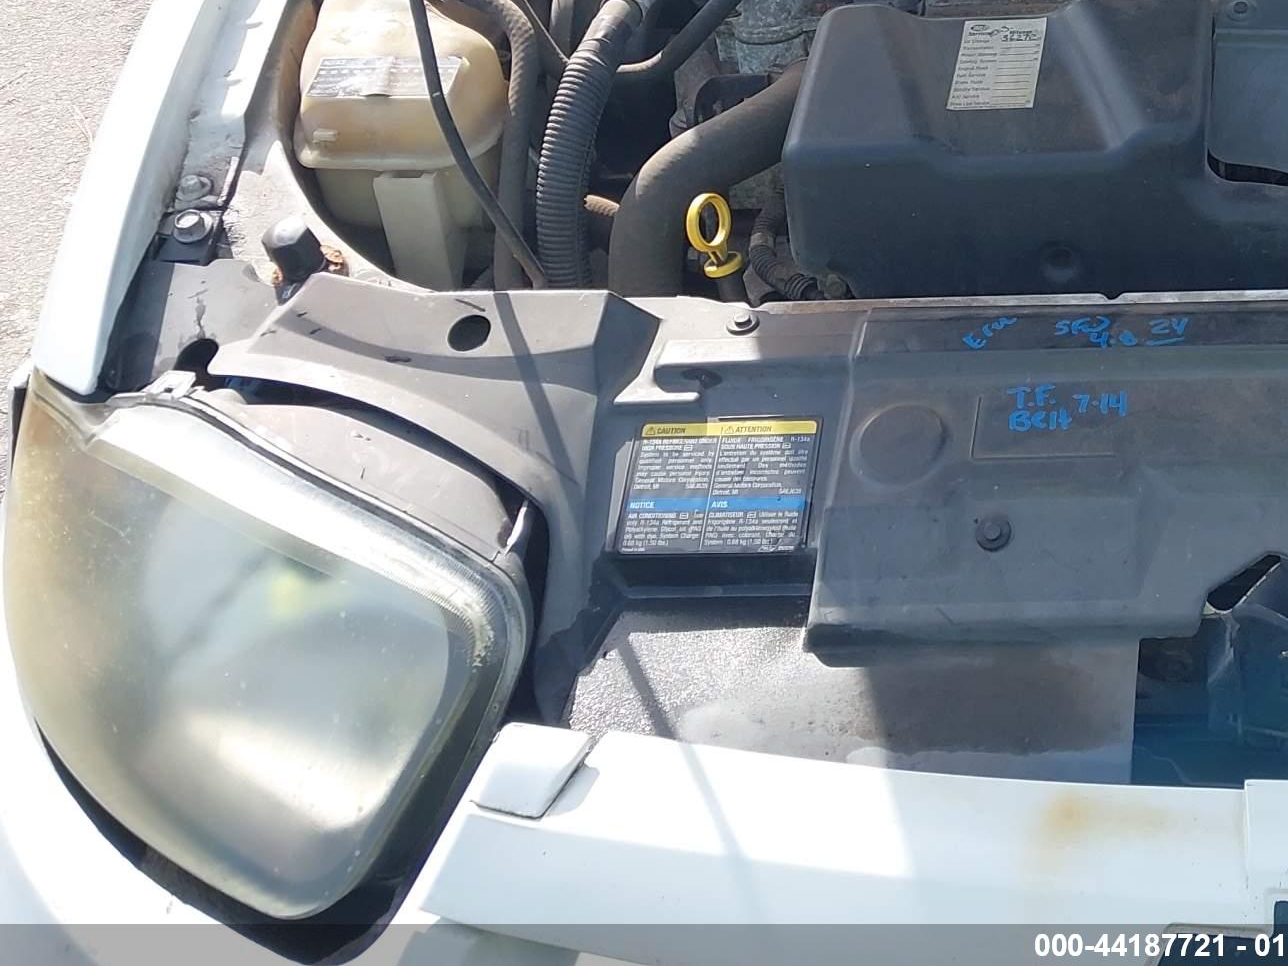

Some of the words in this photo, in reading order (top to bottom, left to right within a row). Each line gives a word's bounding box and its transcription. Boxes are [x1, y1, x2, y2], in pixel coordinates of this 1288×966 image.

[657, 427, 687, 435] CAUTION
[735, 425, 772, 433] ATTENTION
[629, 501, 656, 509] NOTICE
[711, 500, 729, 508] AVIS
